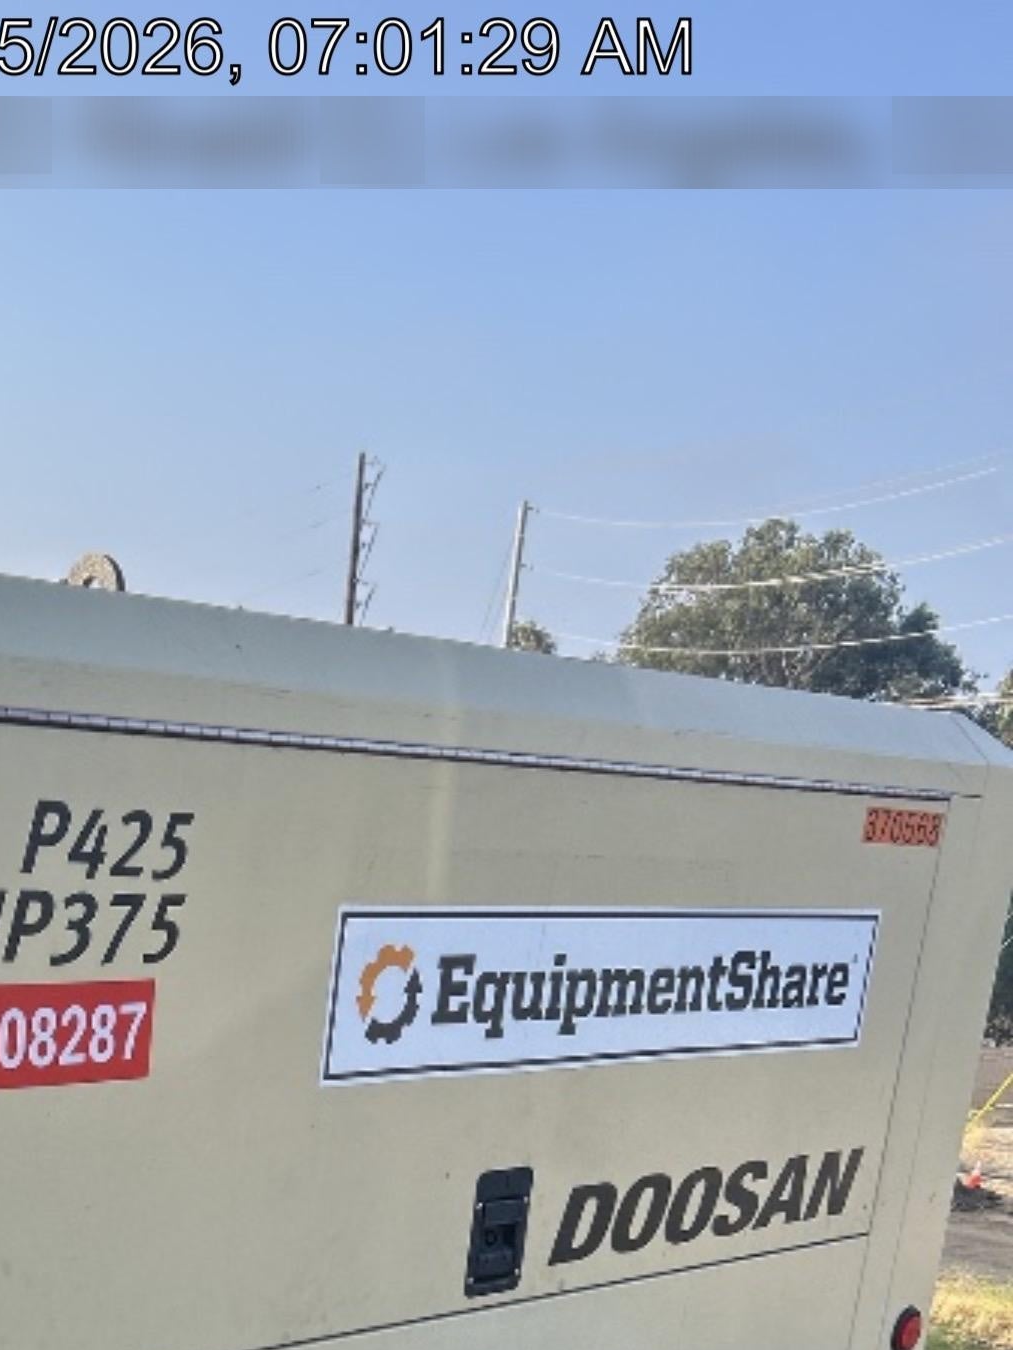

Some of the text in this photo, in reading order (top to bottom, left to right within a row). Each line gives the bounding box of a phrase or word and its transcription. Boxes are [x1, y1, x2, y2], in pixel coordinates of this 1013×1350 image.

[19, 799, 195, 881] P425
[430, 949, 850, 1040] EquipmentShare
[546, 1147, 865, 1268] DOOSAN
